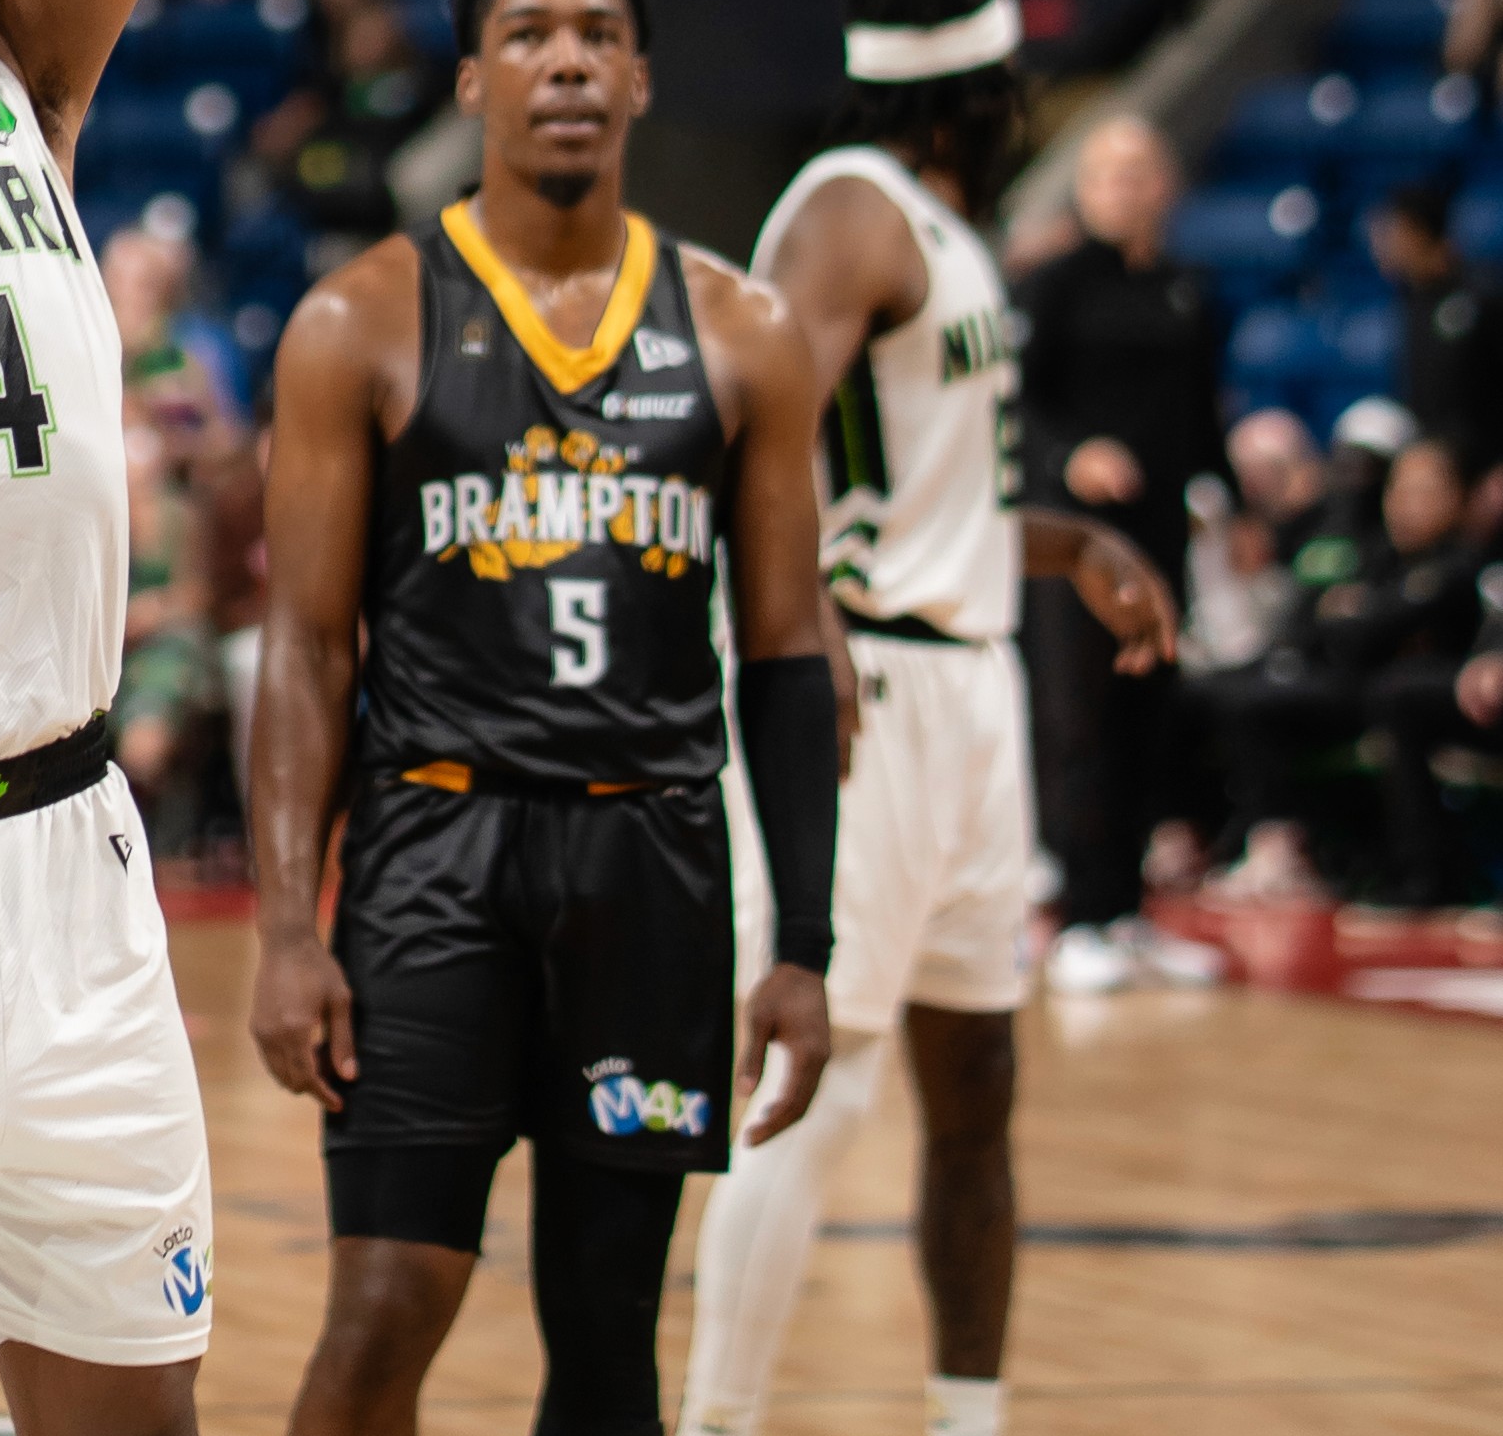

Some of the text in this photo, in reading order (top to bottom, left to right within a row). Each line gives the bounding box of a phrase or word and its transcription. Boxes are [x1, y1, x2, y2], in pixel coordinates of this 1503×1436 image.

[421, 471, 712, 563] BRAMPTON
[545, 577, 608, 687] 5
[152, 1226, 193, 1259] Lotto
